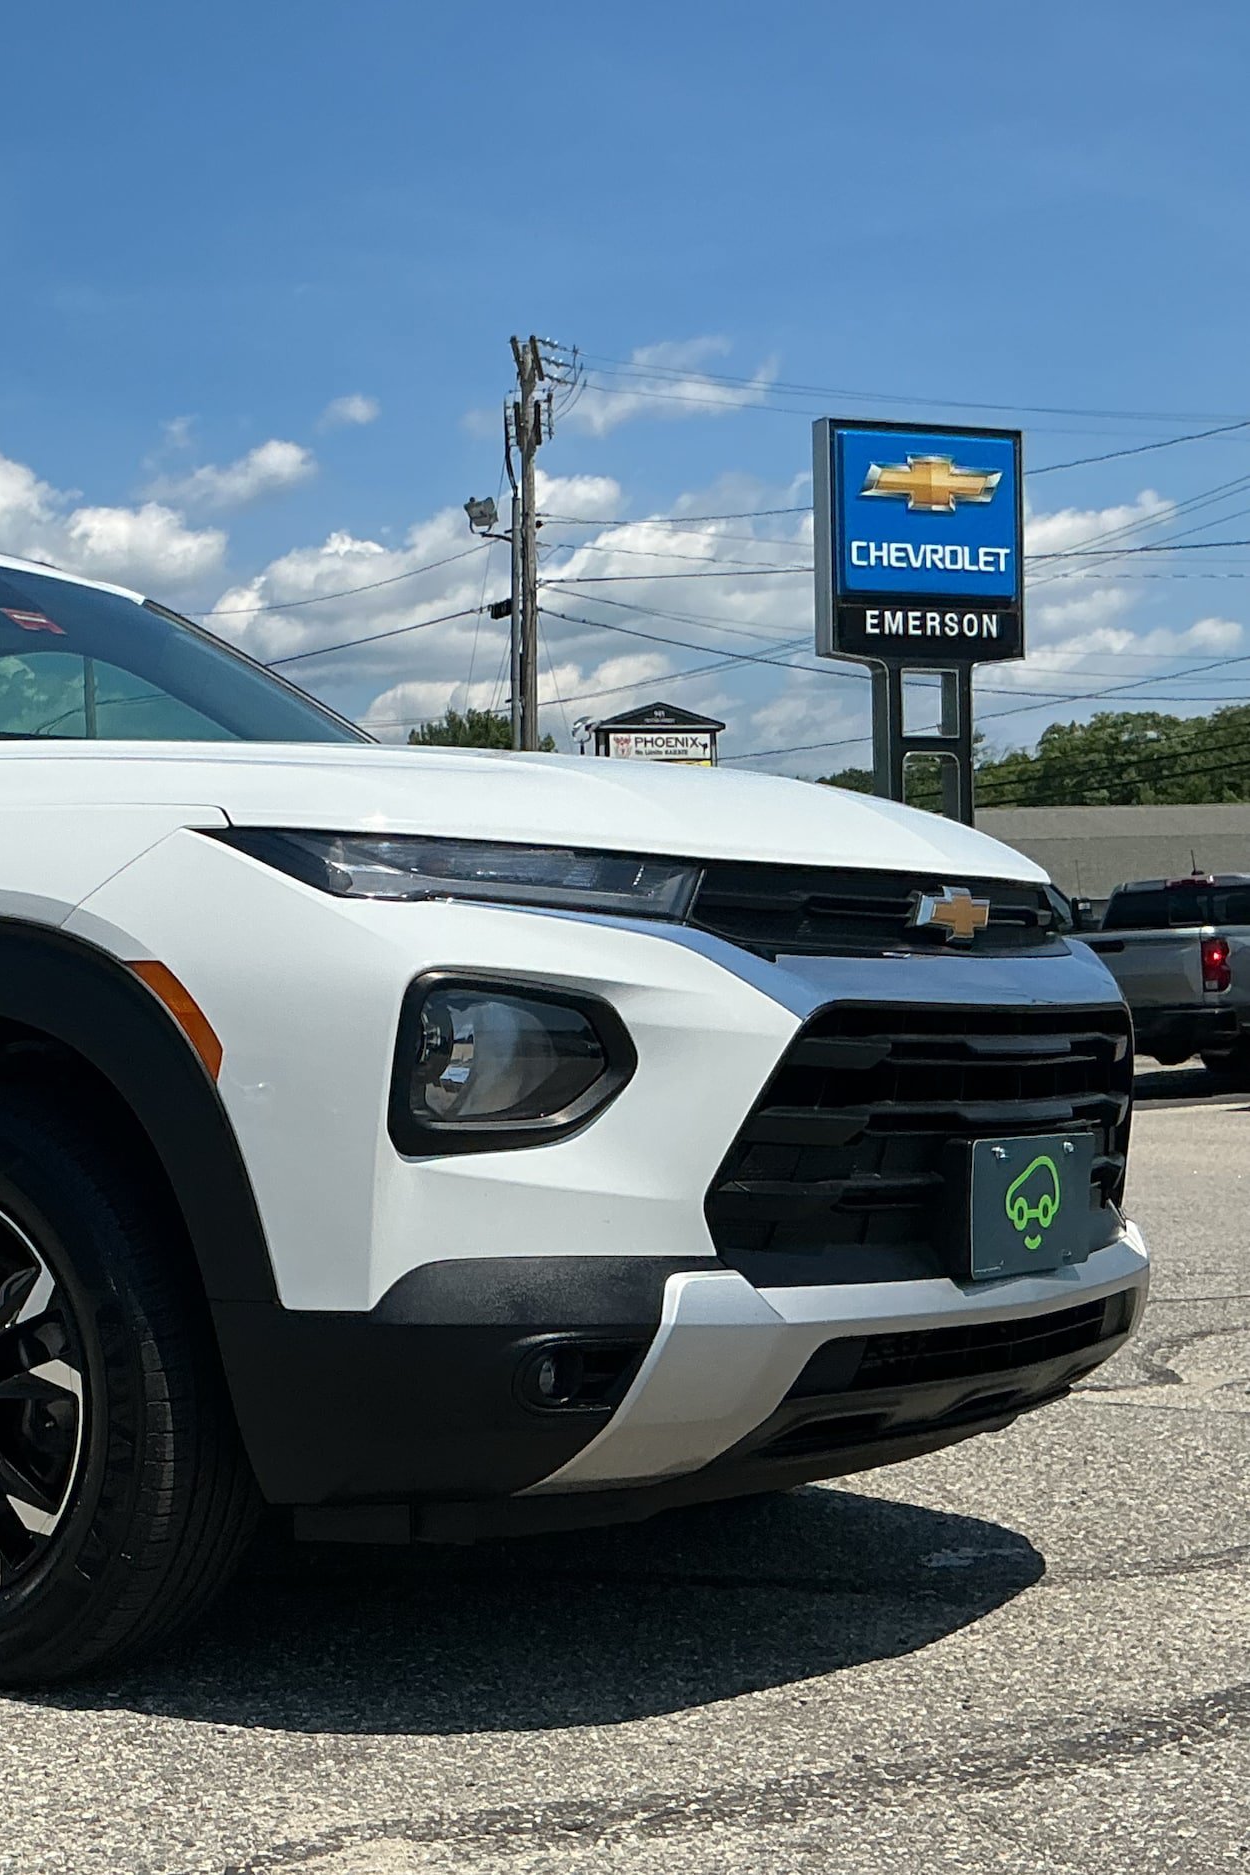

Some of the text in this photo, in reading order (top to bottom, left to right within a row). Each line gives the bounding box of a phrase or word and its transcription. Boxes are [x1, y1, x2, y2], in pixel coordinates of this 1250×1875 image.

[851, 540, 1010, 572] CHEVROLET
[865, 609, 998, 638] EMERSON
[634, 736, 699, 748] PHOENIX
